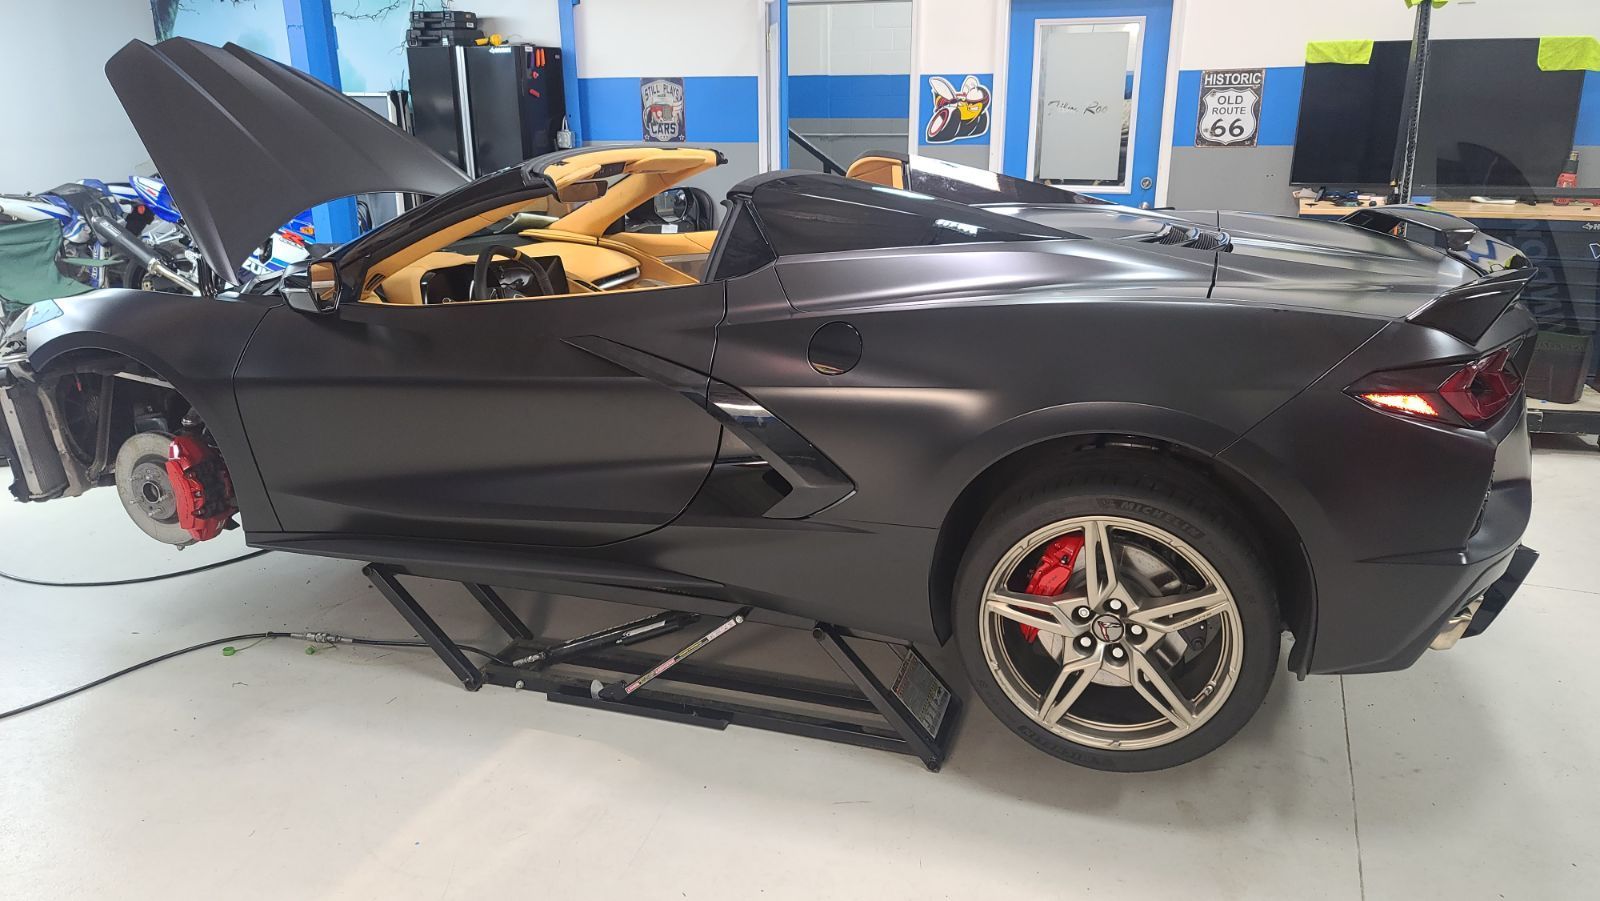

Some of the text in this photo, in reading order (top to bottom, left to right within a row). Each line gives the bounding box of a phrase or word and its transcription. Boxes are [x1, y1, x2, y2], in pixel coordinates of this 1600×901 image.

[1204, 73, 1262, 85] HISTORIC
[645, 84, 682, 101] STILL PLAYS
[1217, 95, 1244, 105] OLD
[1212, 106, 1246, 115] ROUTE
[651, 122, 676, 135] CARS
[1210, 118, 1245, 137] 66
